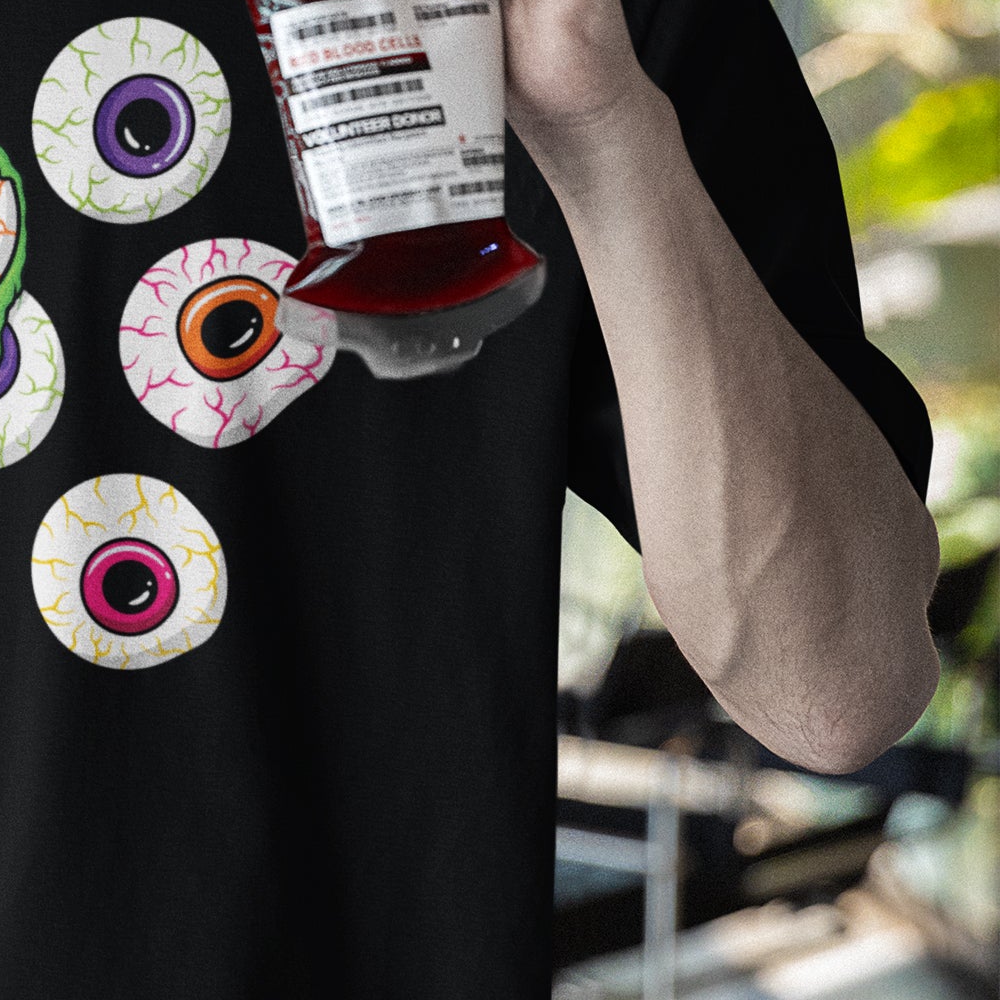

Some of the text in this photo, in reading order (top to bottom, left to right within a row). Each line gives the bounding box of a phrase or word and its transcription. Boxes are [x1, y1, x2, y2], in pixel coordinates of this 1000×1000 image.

[290, 34, 422, 67] RD BLOOD CELLS
[302, 115, 391, 148] VOLUNTEER
[393, 109, 442, 127] DONOR
